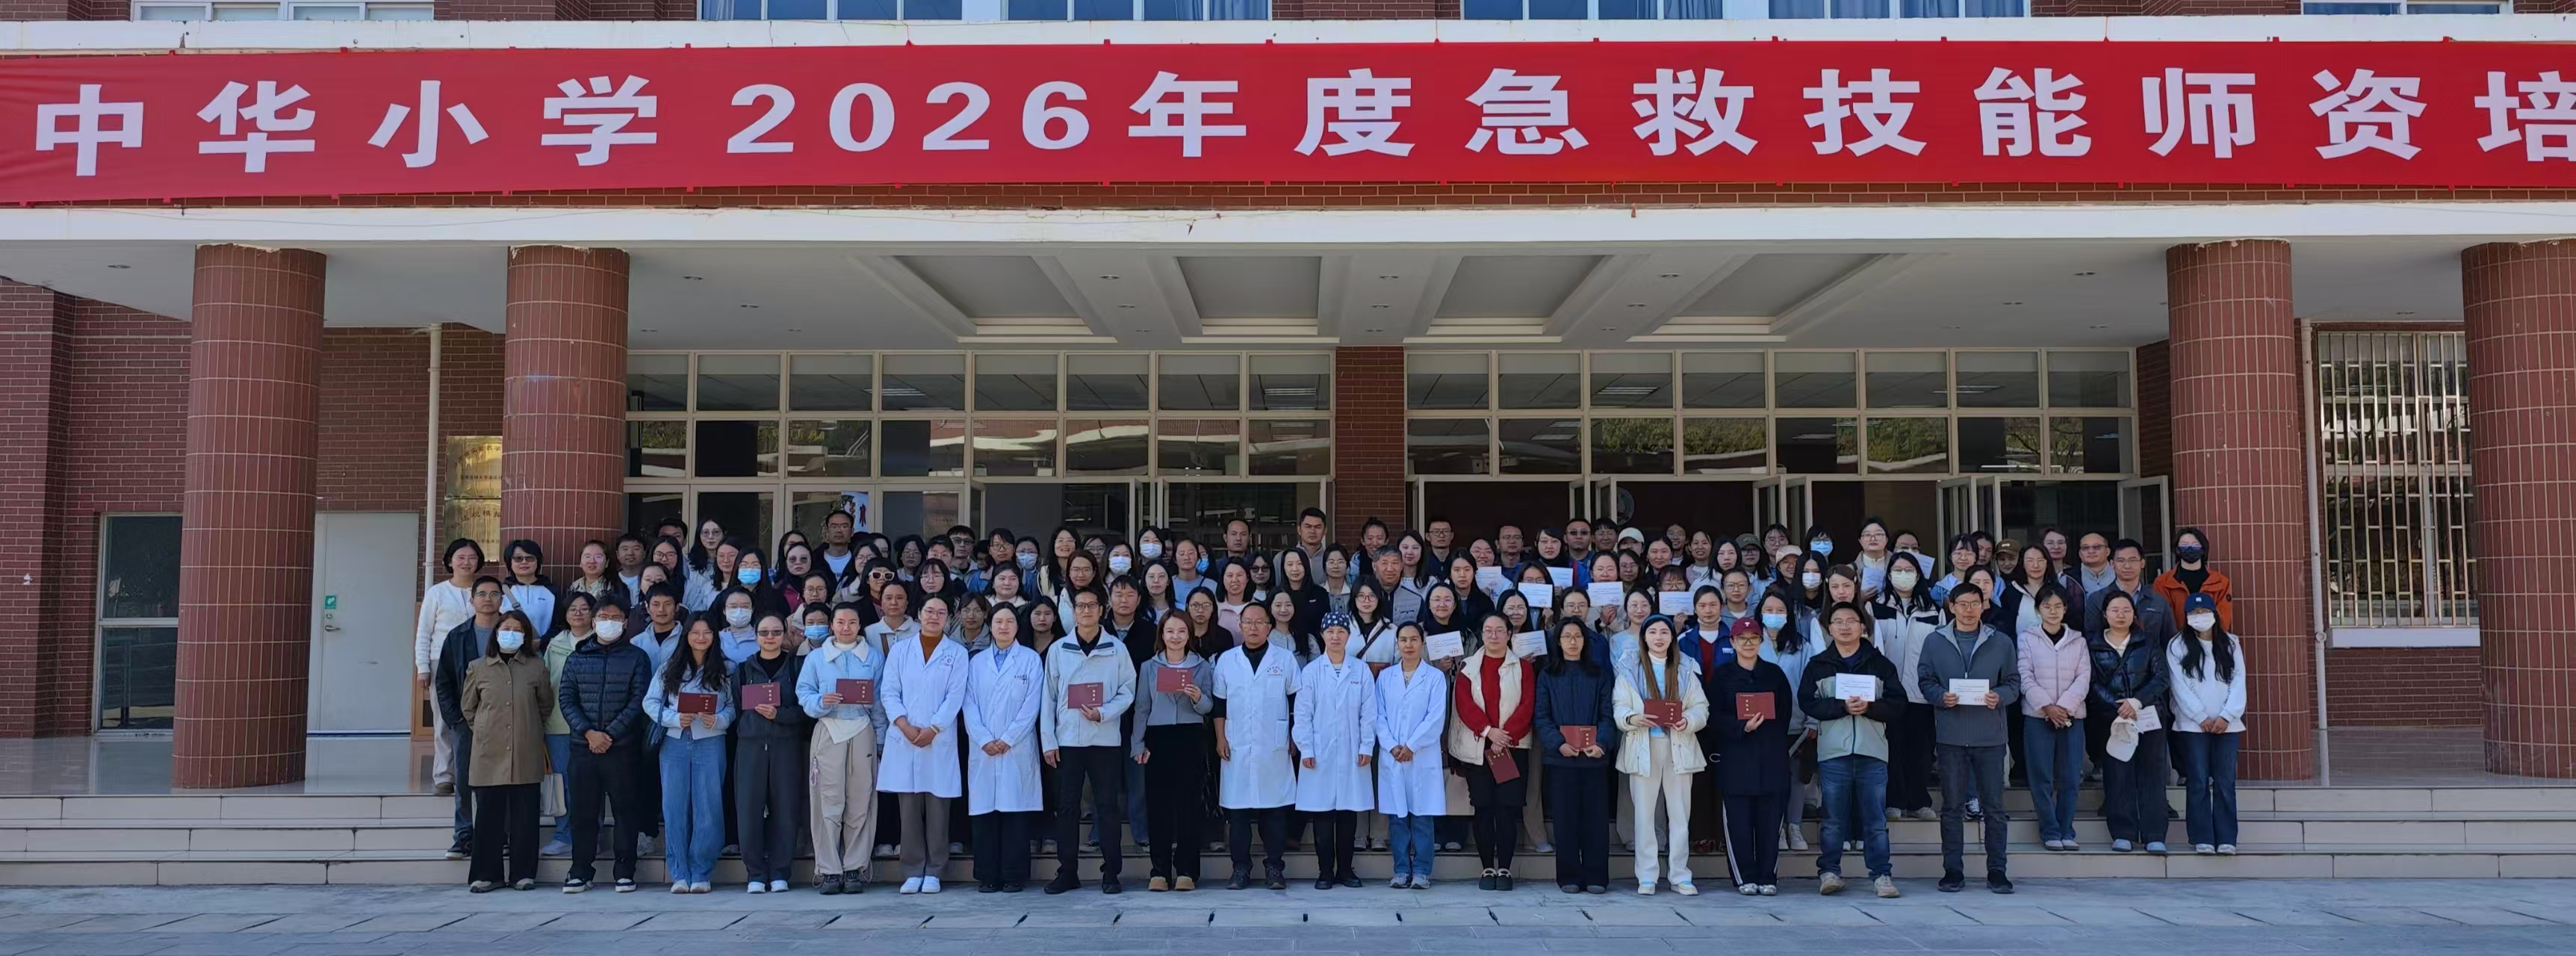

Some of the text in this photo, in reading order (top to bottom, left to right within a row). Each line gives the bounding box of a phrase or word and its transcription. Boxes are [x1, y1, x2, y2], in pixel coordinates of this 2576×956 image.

[36, 67, 2576, 176] 中华小学2026年度急救技能师资培
